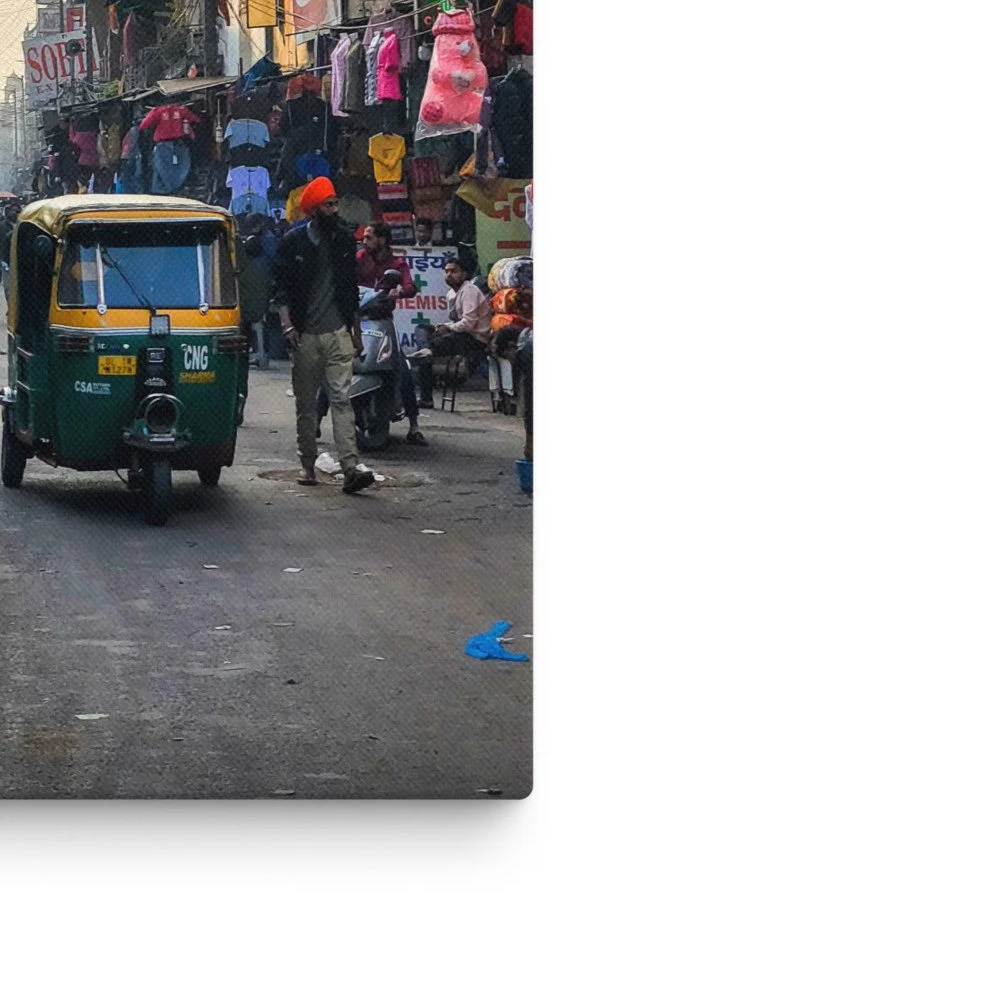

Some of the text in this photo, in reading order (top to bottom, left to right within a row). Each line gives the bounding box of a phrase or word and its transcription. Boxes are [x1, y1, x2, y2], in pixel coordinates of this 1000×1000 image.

[396, 295, 448, 310] HEMIS
[184, 345, 209, 370] CNG
[75, 381, 93, 393] CSA
